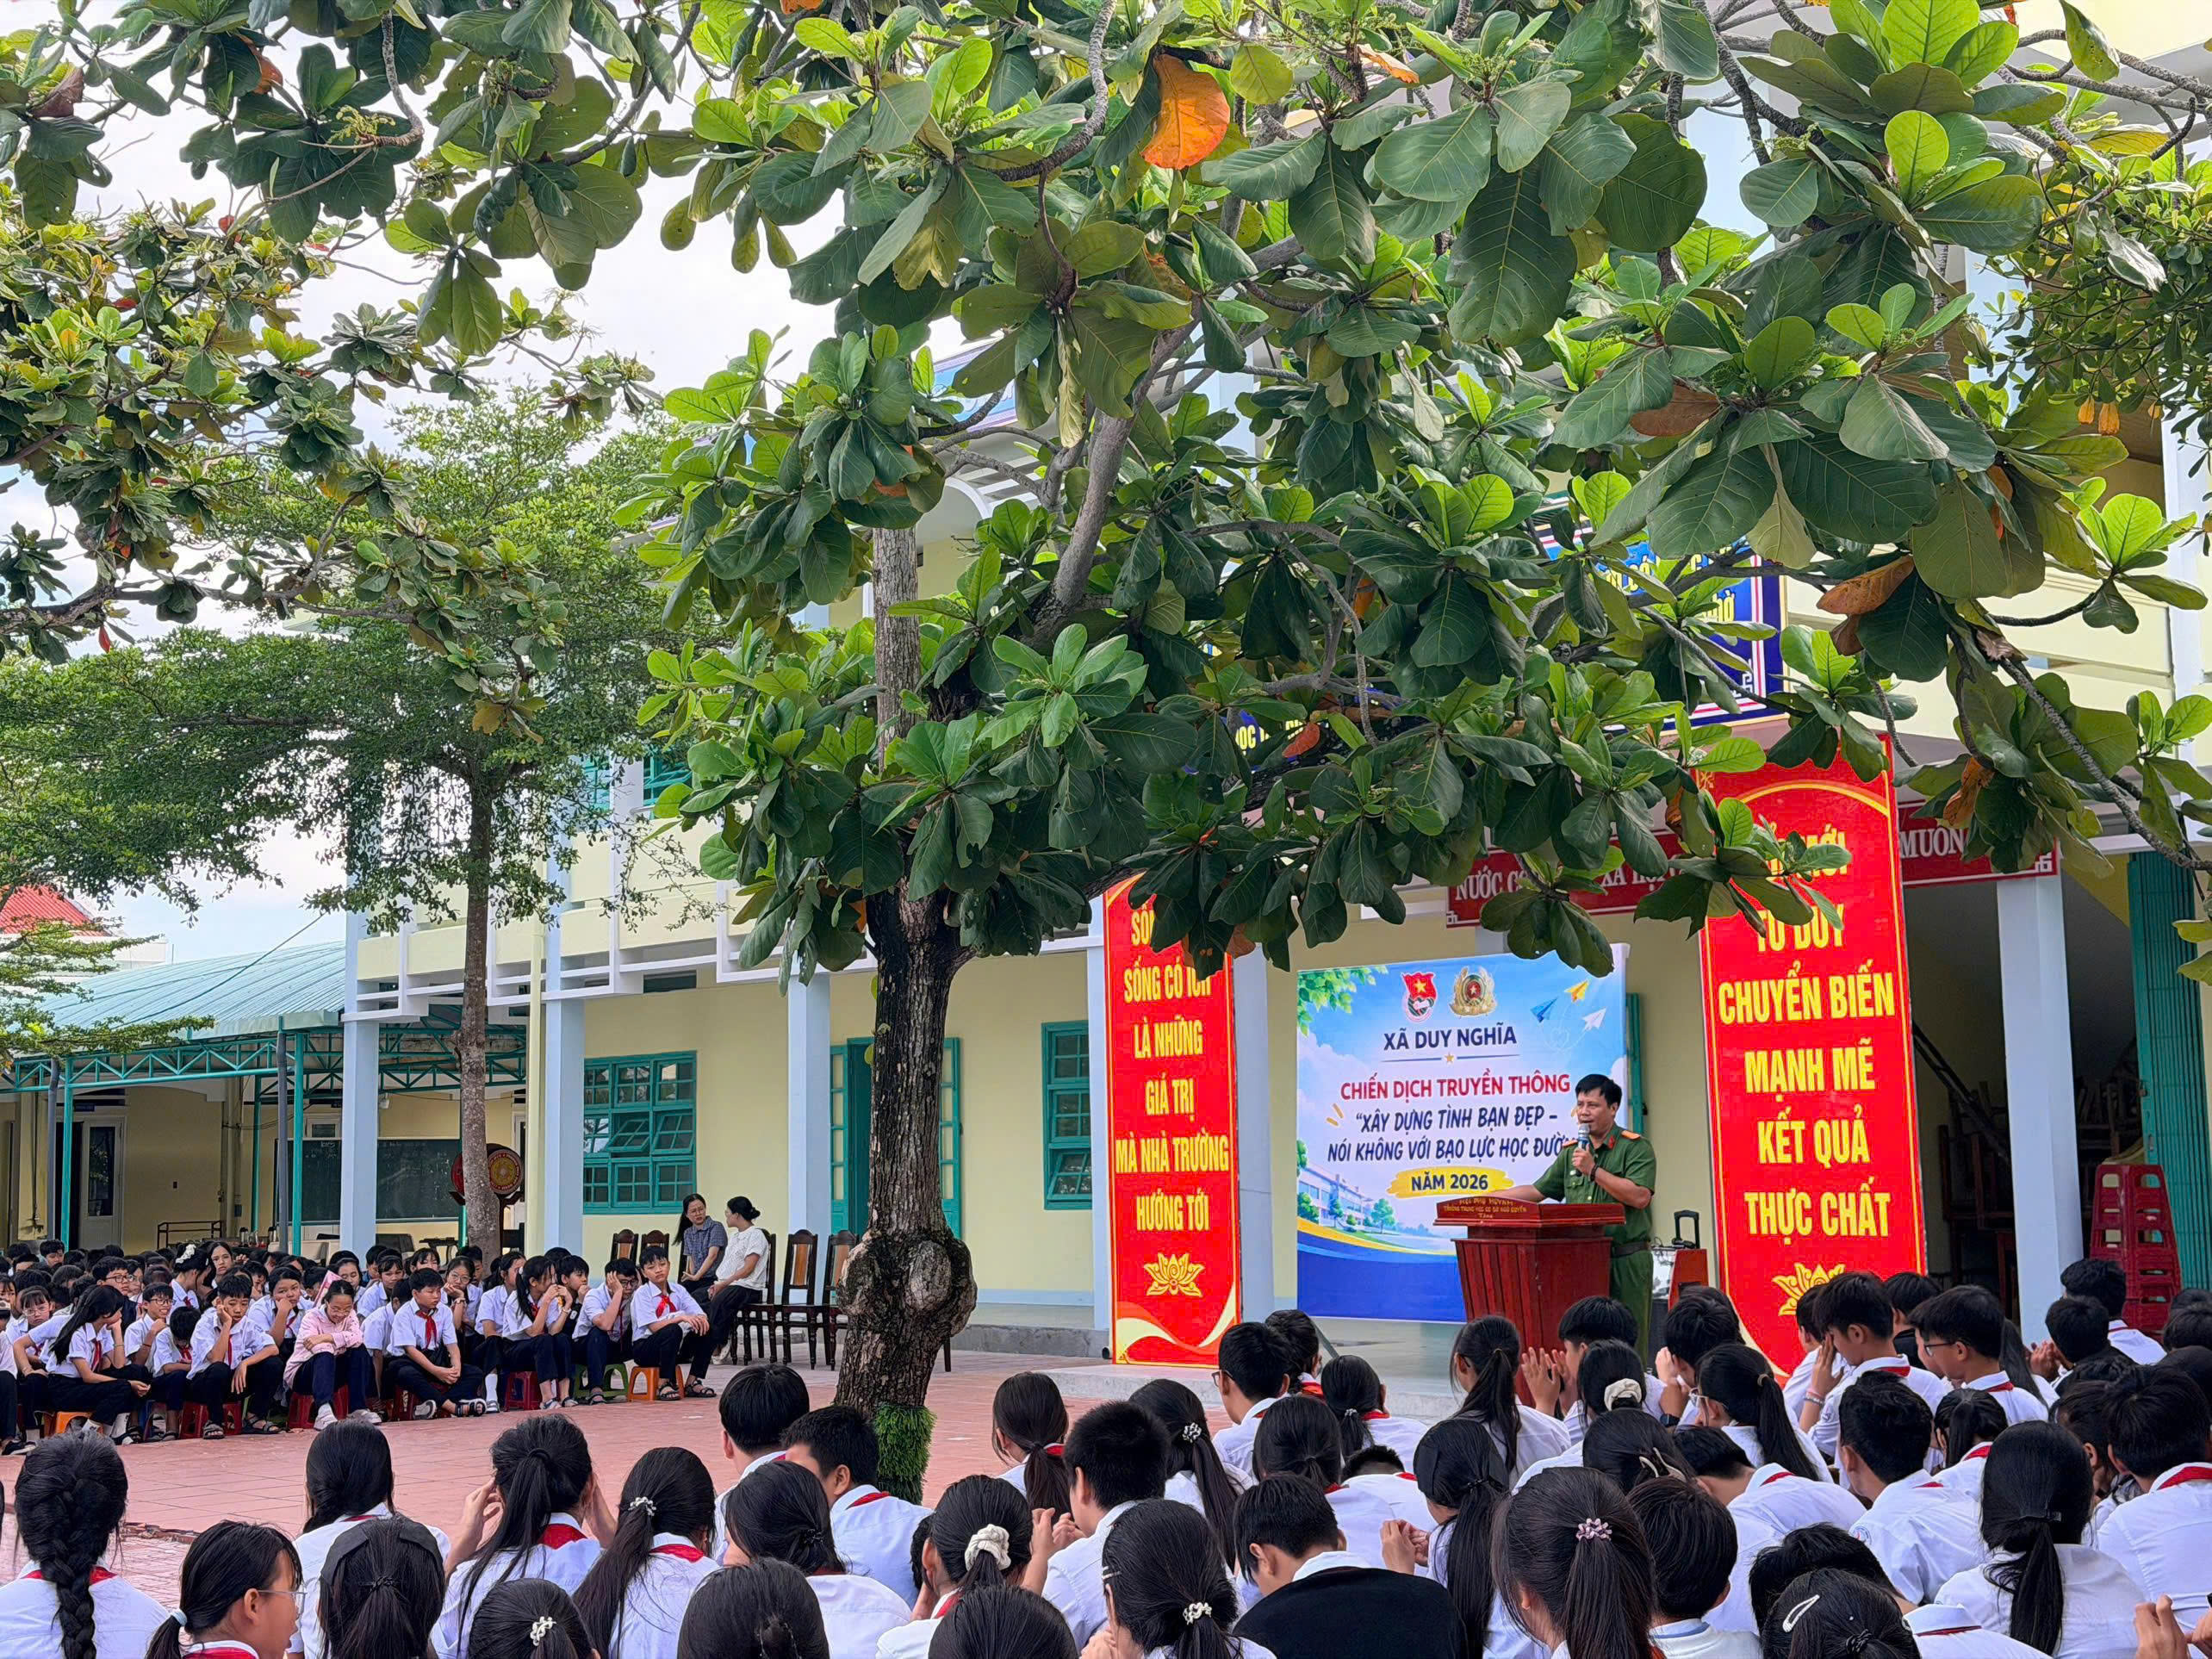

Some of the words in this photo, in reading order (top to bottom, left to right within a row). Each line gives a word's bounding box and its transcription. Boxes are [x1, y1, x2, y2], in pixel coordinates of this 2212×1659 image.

[1455, 865, 1503, 901] NƯỚC
[1124, 954, 1162, 1003] SỐNG
[1164, 955, 1184, 999] CÓ
[1718, 960, 1823, 1025] CHUYỂN
[1829, 959, 1896, 1019] BIẾN
[1134, 1016, 1153, 1059] LÀ
[1153, 1014, 1204, 1058] NHỮNG
[1383, 1028, 1410, 1050] XÃ
[1414, 1029, 1452, 1048] DUY
[1457, 1022, 1517, 1047] NGHĨA
[1340, 1072, 1388, 1100] CHIẾN
[1393, 1079, 1432, 1103] DỊCH
[1437, 1068, 1503, 1097] TRUYỀN
[1508, 1070, 1571, 1094] THÔNG
[1744, 1047, 1825, 1103] MẠNH
[1831, 1037, 1875, 1091] MẼ
[1145, 1072, 1170, 1115] GIÁ
[1171, 1077, 1196, 1122] TRỊ
[1395, 1109, 1432, 1135] DỰNG
[1438, 1104, 1472, 1128] TÌNH
[1479, 1107, 1510, 1131] BẠN
[1514, 1105, 1544, 1131] ĐẸP
[1115, 1130, 1138, 1173] MÀ
[1140, 1129, 1170, 1172] NHÀ
[1172, 1127, 1229, 1172] TRƯỜNG
[1328, 1139, 1351, 1162] NÓI
[1355, 1135, 1403, 1161] KHÔNG
[1408, 1135, 1432, 1159] VỚI
[1435, 1139, 1465, 1163] BẠO
[1469, 1137, 1496, 1163] LỰC
[1500, 1138, 1529, 1162] HỌC
[1757, 1105, 1805, 1164] KẾT
[1812, 1103, 1871, 1169] QUẢ
[1411, 1171, 1445, 1191] NĂM
[1450, 1174, 1488, 1190] 2026
[1136, 1187, 1184, 1232] HƯỚNG
[1186, 1187, 1210, 1232] TỚI
[1743, 1187, 1812, 1246] THỰC
[1820, 1176, 1891, 1237] CHẤT
